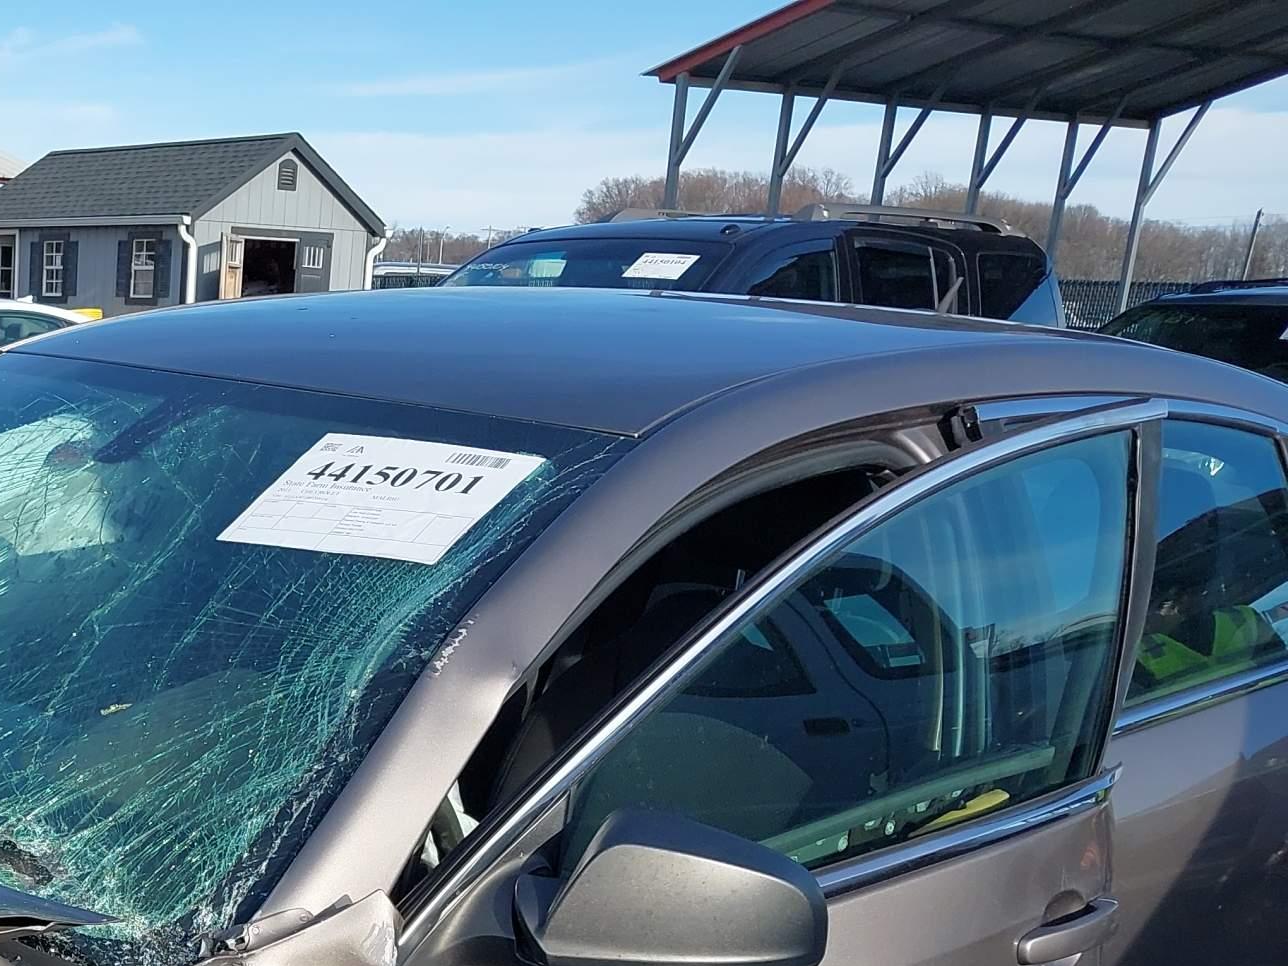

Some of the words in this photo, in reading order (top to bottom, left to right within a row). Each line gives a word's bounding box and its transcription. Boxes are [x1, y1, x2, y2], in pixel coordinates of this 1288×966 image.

[283, 479, 305, 487] State
[306, 480, 328, 489] Farm
[330, 481, 372, 492] Insurance
[307, 461, 485, 495] 44150701
